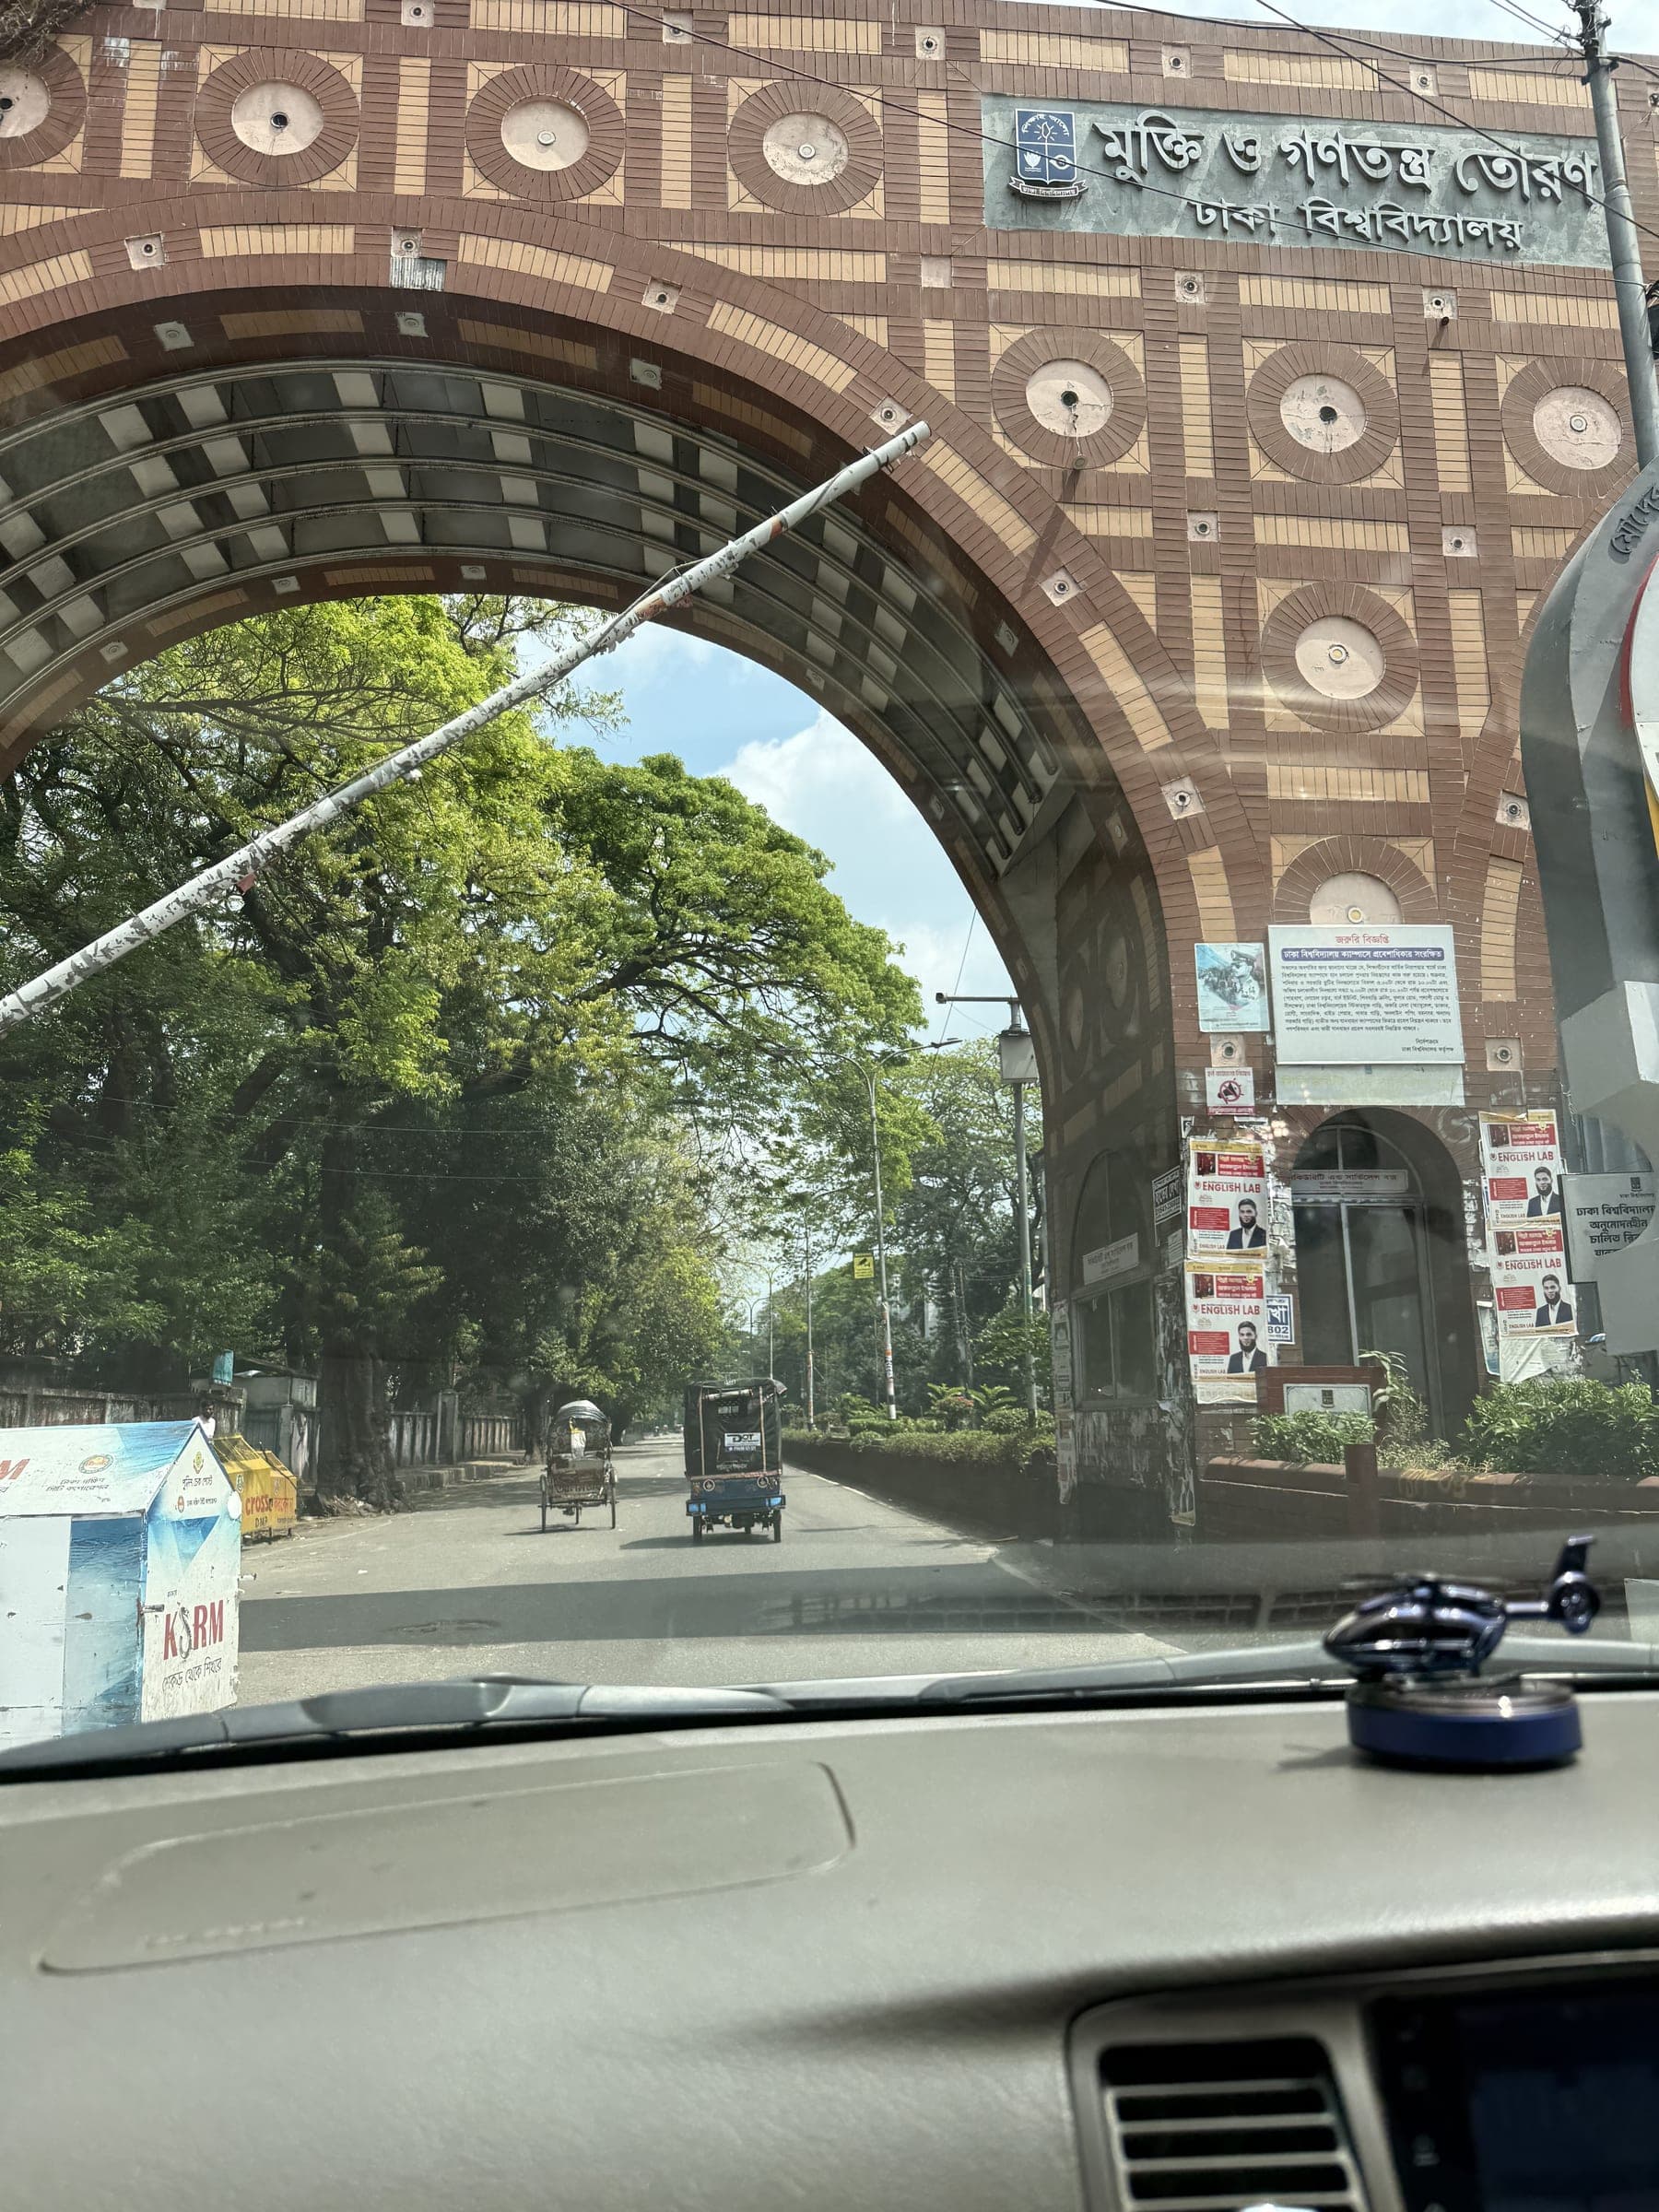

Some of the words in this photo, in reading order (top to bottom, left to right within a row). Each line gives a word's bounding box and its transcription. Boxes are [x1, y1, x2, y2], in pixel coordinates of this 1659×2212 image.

[1092, 109, 1205, 190] মুক্তি
[1221, 133, 1262, 175] ও
[1278, 128, 1436, 194] গণতন্ত্র
[1453, 146, 1597, 206] তোরণ
[1188, 197, 1281, 237] ঢাকা
[1297, 195, 1524, 251] বিশ্ববিদ্যালয়
[1335, 934, 1360, 945] জরুরি
[1498, 1151, 1535, 1161] ENGLISH
[1537, 1150, 1554, 1161] LAB
[1202, 1181, 1241, 1193] ENGLISH
[1243, 1182, 1261, 1194] LAB
[1576, 1206, 1599, 1217] ঢাকা
[1589, 1231, 1620, 1244] চালিত
[1504, 1258, 1543, 1270] ENGLISH
[1545, 1257, 1562, 1269] LAB
[1201, 1304, 1241, 1315] ENGLISH
[1242, 1304, 1261, 1315] LAB
[163, 1599, 224, 1661] KSRM
